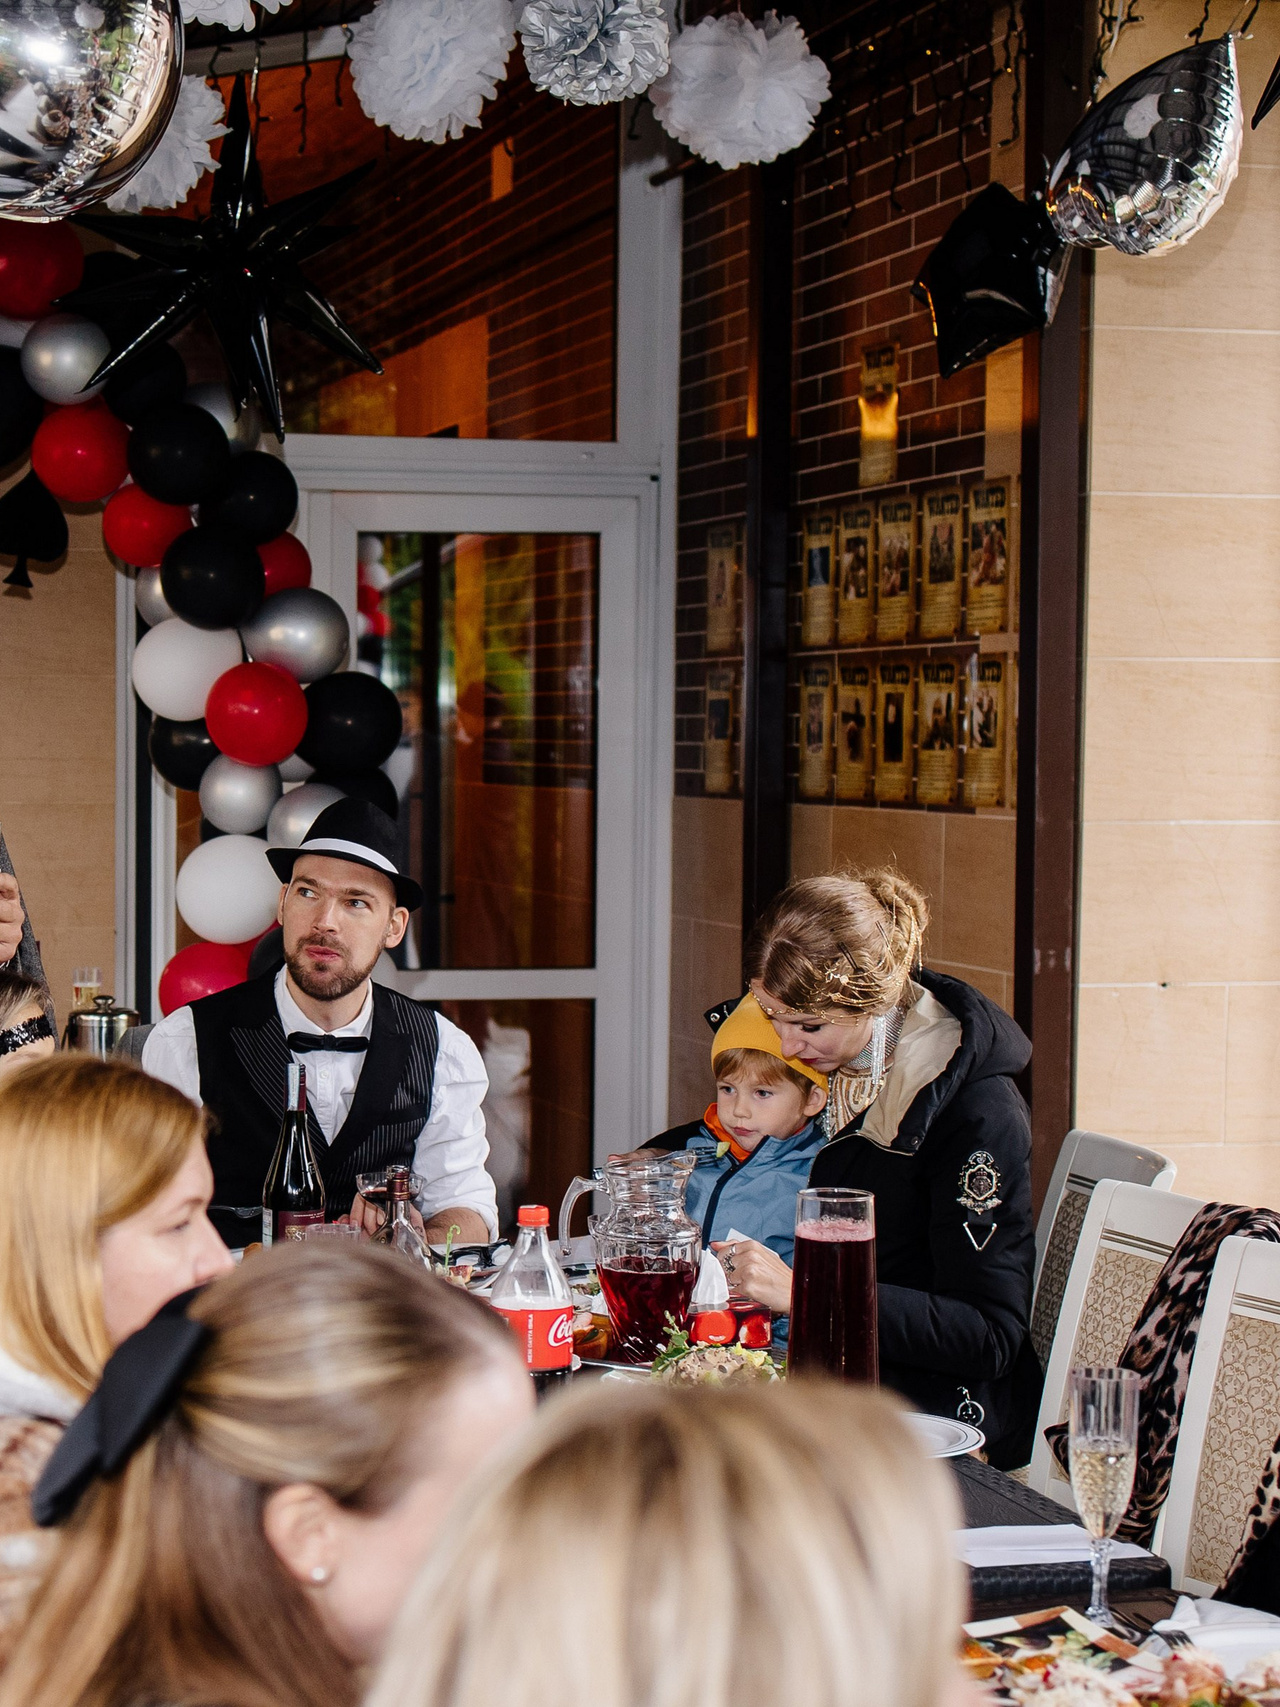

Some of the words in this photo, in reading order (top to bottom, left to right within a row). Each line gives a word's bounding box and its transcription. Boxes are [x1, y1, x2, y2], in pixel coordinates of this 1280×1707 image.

[927, 493, 961, 517] WANTED
[973, 486, 1006, 509] WANTED
[881, 502, 912, 524] WANTED
[840, 665, 869, 686] WANTED
[880, 664, 910, 685] WANTED
[923, 662, 955, 685] WANTED
